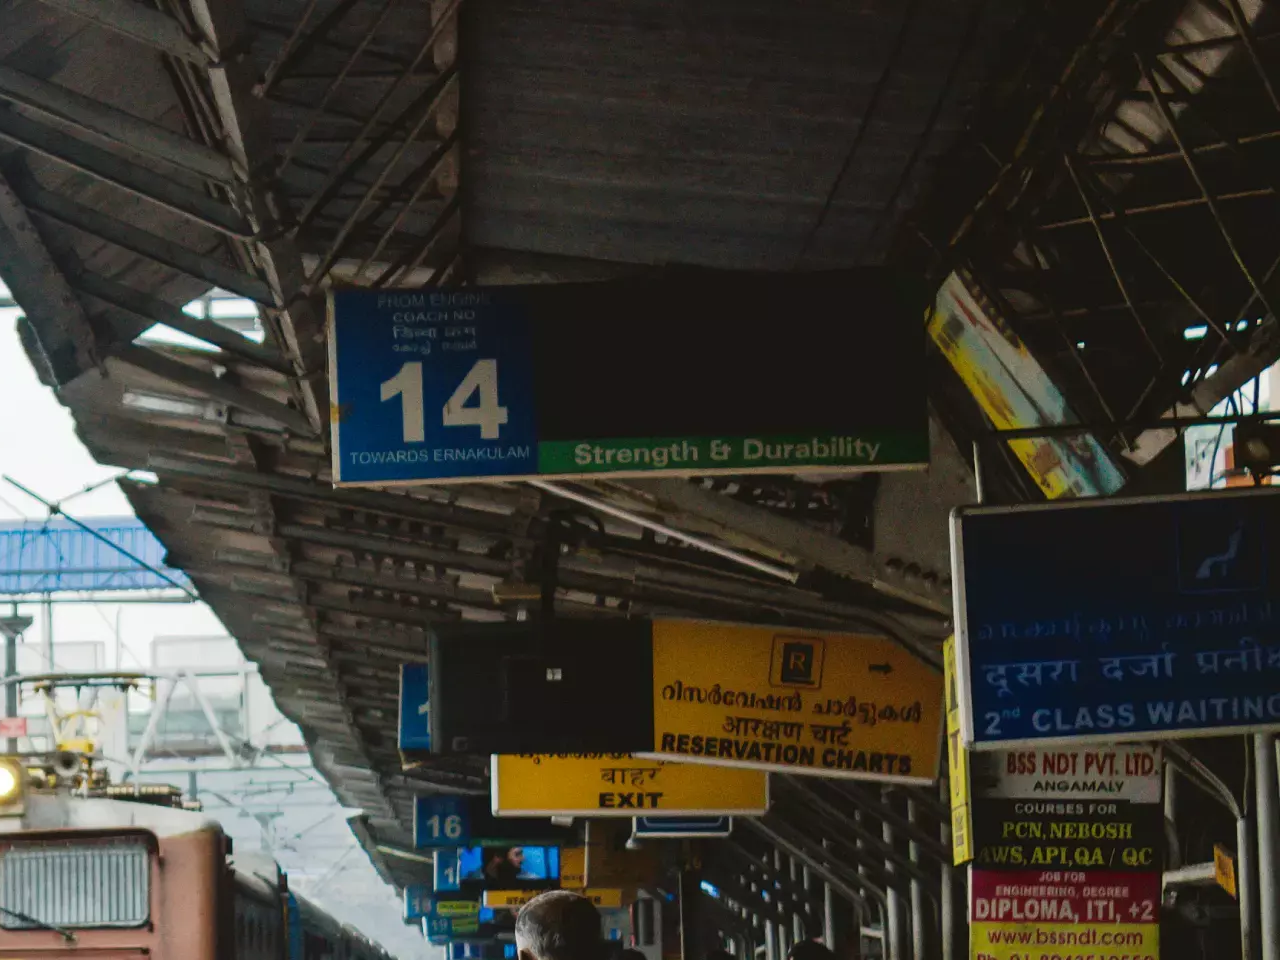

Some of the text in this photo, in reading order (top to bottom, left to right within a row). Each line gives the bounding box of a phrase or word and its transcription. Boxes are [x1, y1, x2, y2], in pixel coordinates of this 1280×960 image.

[393, 309, 476, 323] COACH NO
[380, 358, 508, 443] 14
[349, 444, 530, 465] TOWARDS ERNAKULAM
[573, 437, 881, 467] Strength & Durability
[981, 659, 1081, 698] दूसरा
[1098, 641, 1177, 681] दर्जा
[722, 714, 804, 741] आरक्षण
[983, 705, 1021, 736] 2nd
[1031, 703, 1135, 732] CLASS
[660, 731, 816, 763] RESERVATION
[821, 746, 913, 775] CHARTS
[1007, 751, 1160, 776] BSS NDT PVT. LTD.
[1033, 780, 1124, 792] ANGAMALY
[598, 791, 664, 808] EXIT
[1014, 803, 1117, 815] COURSES FOR
[426, 814, 462, 838] 16
[1121, 846, 1153, 867] QC
[1038, 871, 1086, 883] JOB FOR
[994, 885, 1129, 898] ENGINEERING, DEGREE
[975, 898, 1156, 924] DIPLOMA, ITI, +2
[988, 928, 1144, 945] www.bssndt.com
